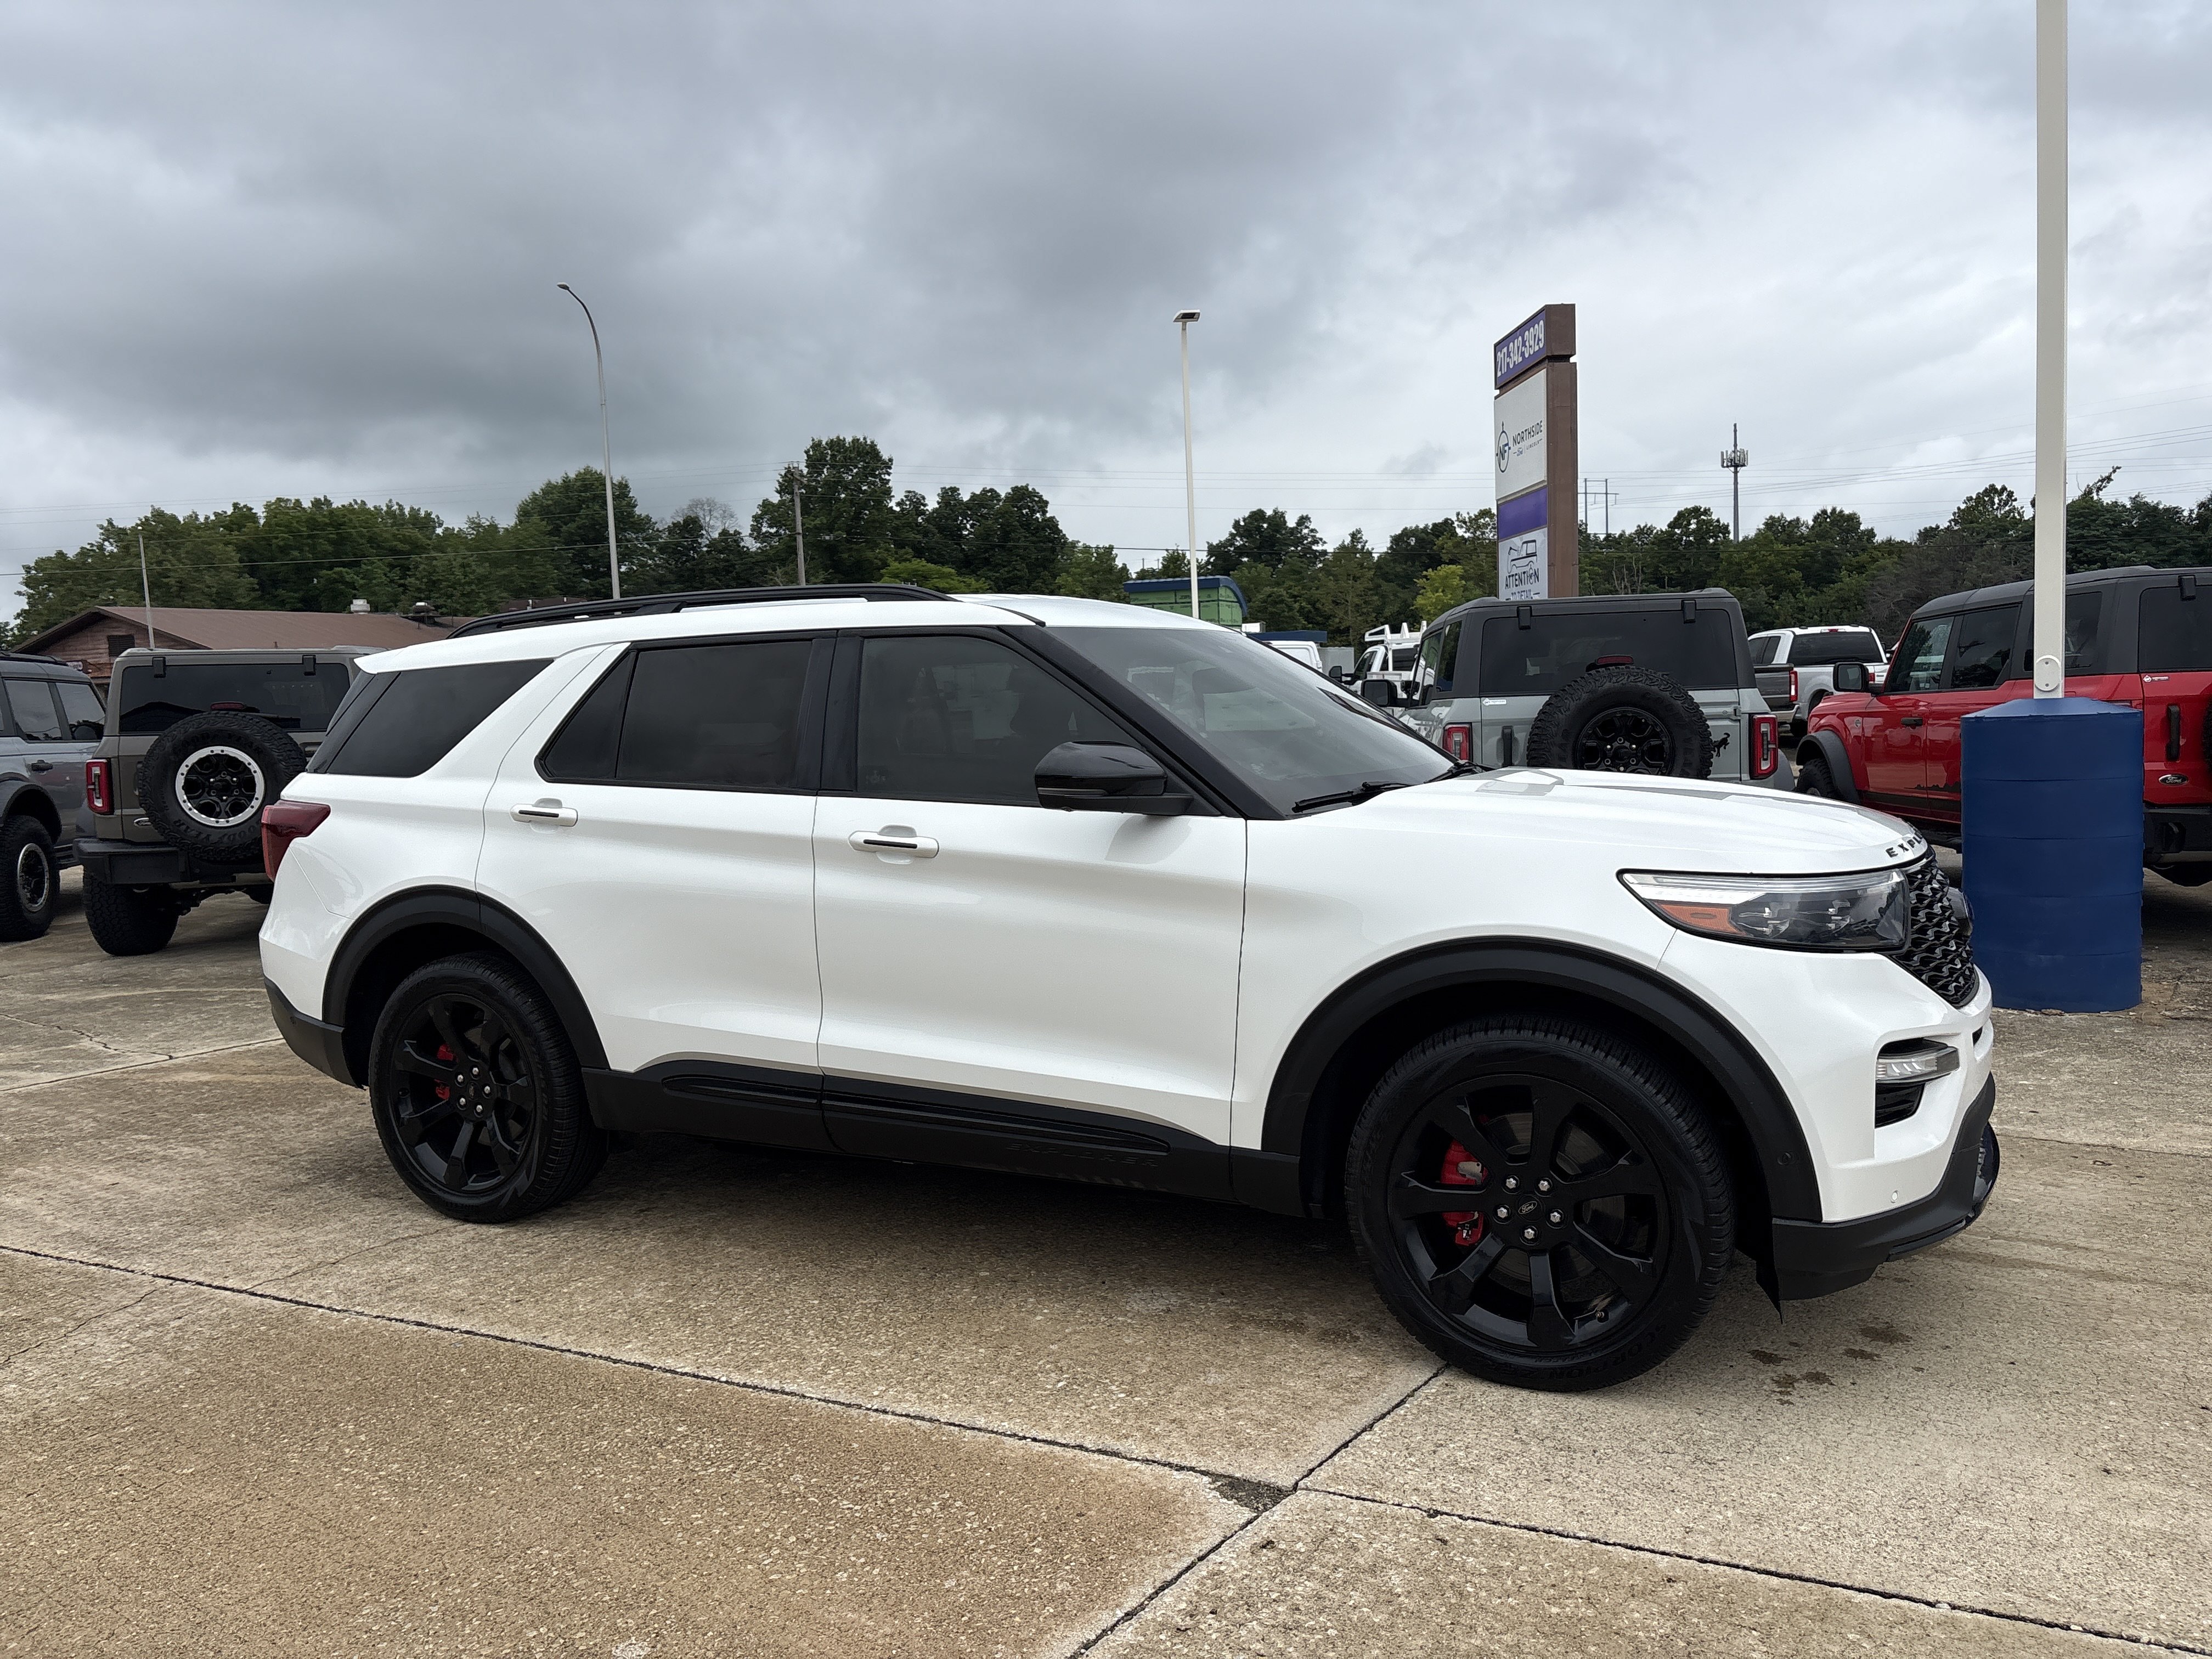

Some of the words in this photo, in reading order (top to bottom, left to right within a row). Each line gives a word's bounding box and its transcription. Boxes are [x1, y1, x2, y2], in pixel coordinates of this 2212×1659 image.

[1497, 320, 1544, 377] 217-342-3929
[1513, 420, 1542, 447] NORTHSIDE
[1505, 568, 1539, 589] ATTENTION
[1006, 1143, 1158, 1167] EXPLORER
[1521, 1203, 1533, 1213] Ford
